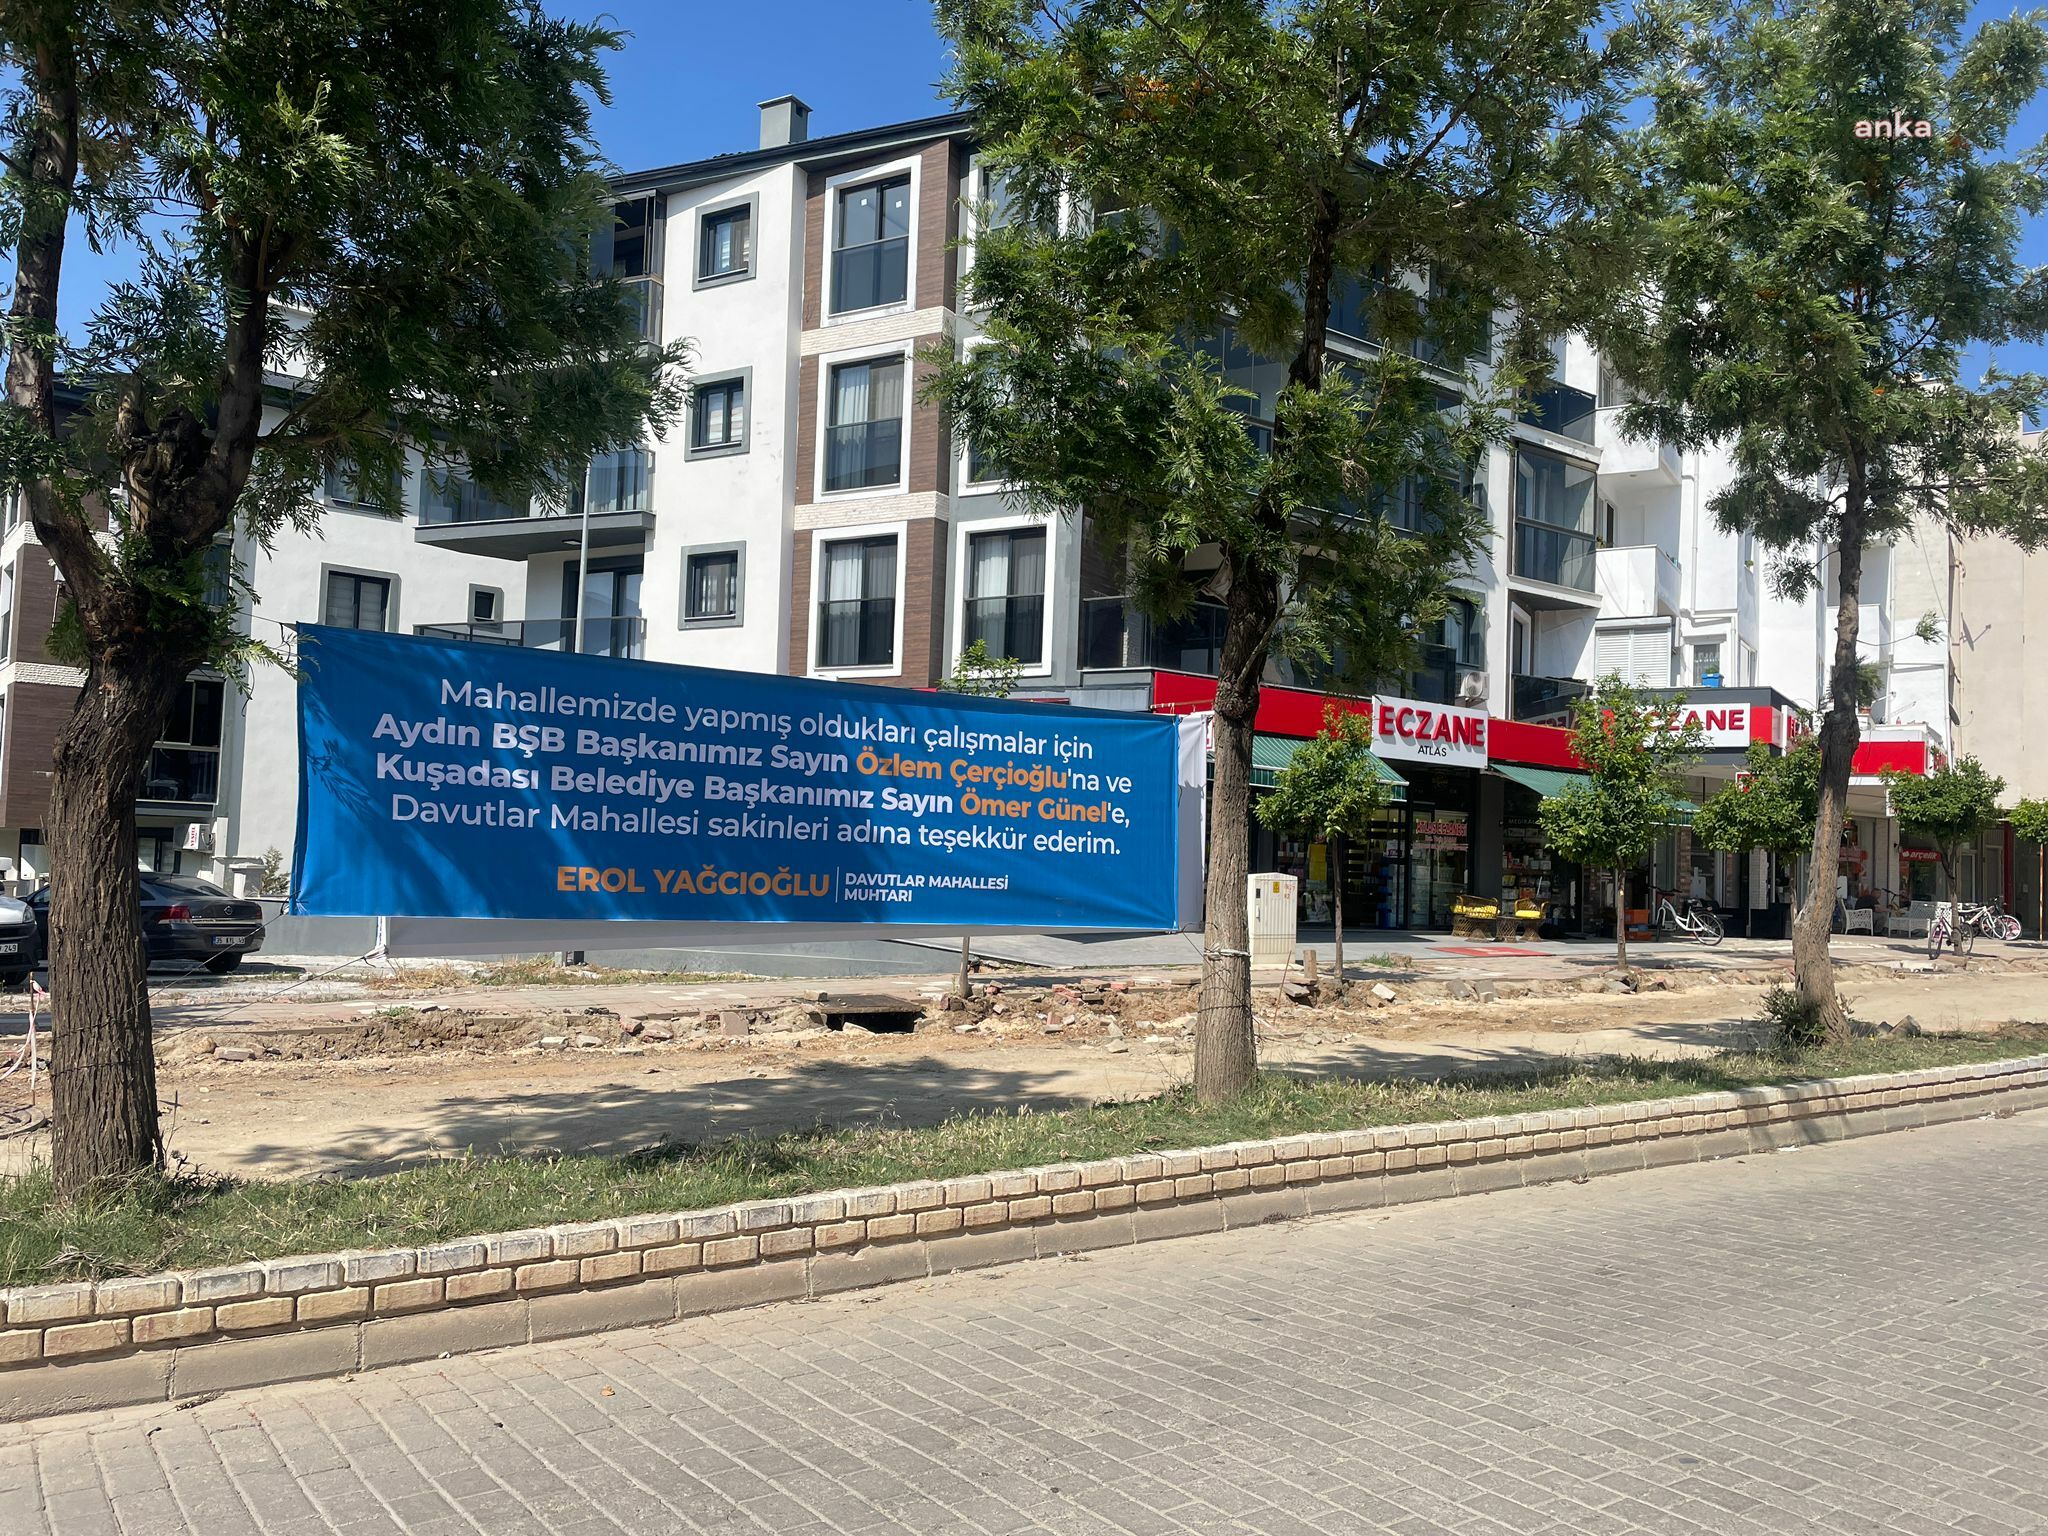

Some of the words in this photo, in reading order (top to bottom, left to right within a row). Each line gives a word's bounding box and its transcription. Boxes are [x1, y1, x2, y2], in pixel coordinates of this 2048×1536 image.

[442, 679, 675, 722] Mahallemizde
[685, 708, 791, 739] yapmış
[800, 713, 915, 743] oldukları
[924, 726, 1046, 755] çalışmalar
[1055, 735, 1092, 763] için
[1379, 704, 1485, 746] ECZANE
[373, 714, 479, 747] Aydın
[493, 723, 564, 758] BŞB
[577, 730, 761, 766] Başkanımız
[771, 745, 847, 775] Sayın
[857, 746, 941, 779] Özlem
[950, 759, 1099, 792] Çerçioğlu'na
[1106, 776, 1131, 793] ve
[1417, 745, 1447, 757] ATLAS
[378, 753, 538, 790] Kuşadası
[552, 767, 693, 802] Belediye
[705, 776, 873, 808] Başkanımız
[882, 788, 952, 817] Sayın
[961, 787, 1031, 817] Ömer
[393, 795, 539, 827] Davutlar
[552, 805, 698, 834] Mahallesi
[709, 813, 828, 840] sakinleri
[838, 820, 910, 844] adına
[919, 825, 1026, 852] teşekkür
[1034, 830, 1120, 854] ederim.
[1909, 851, 1937, 860] arçelik
[557, 866, 644, 893] EROL
[653, 866, 829, 896] YAĞCIOĞLU
[845, 889, 912, 901] MUHTARI
[846, 874, 924, 886] DAVUTLAR
